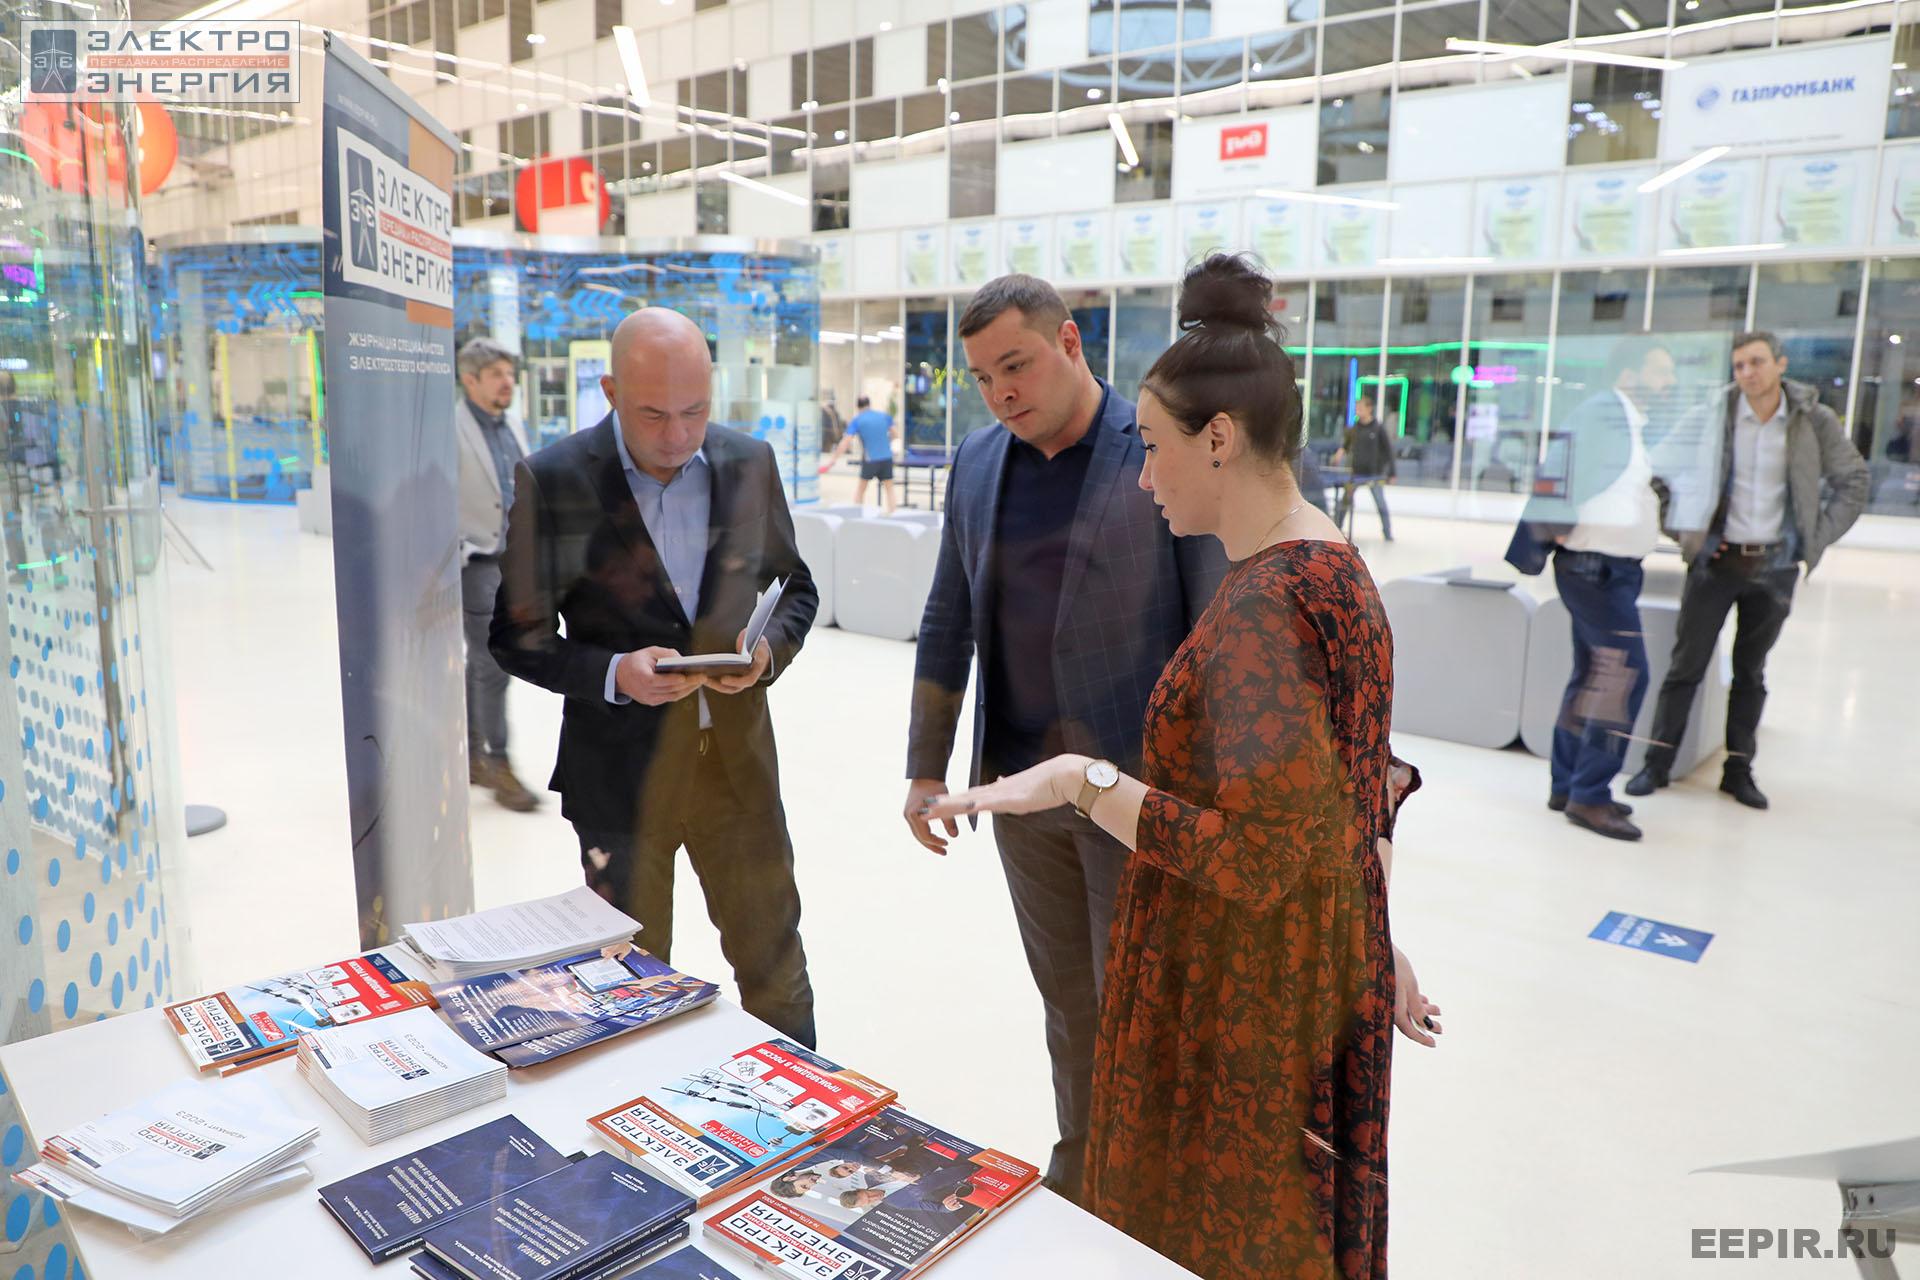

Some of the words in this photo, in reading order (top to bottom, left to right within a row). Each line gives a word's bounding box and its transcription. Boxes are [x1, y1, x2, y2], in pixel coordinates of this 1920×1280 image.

[1732, 76, 1857, 102] ГАЗПРОМБАНК
[180, 1005, 214, 1045] ЭЛЕКТРО
[201, 1000, 237, 1038] ЭНЕРГИЯ
[367, 1043, 406, 1074] ЭЛЕКТРО
[382, 1039, 422, 1070] ЭНЕРГИЯ
[756, 1047, 787, 1063] РОССИИ
[788, 1064, 842, 1092] ПРОИЗВОДИМ
[174, 1110, 206, 1125] 2023
[136, 1129, 196, 1156] ЭЛЕКТРО
[153, 1120, 212, 1147] ЭНЕРГИЯ
[609, 1116, 689, 1166] ЭЛЕКТРО
[628, 1107, 709, 1156] ЭНЕРГИЯ
[701, 1123, 745, 1148] АРМАТЕХ
[395, 1200, 424, 1225] ОЦЕНКА
[874, 1210, 911, 1229] аттестацию
[741, 1213, 799, 1246] РАСПРЕДЕЛЕНИЕ
[748, 1204, 852, 1265] ЭНЕРГИЯ
[860, 1218, 890, 1233] силового
[877, 1219, 908, 1235] первыми
[887, 1232, 914, 1244] защиты
[908, 1227, 936, 1241] прошли
[924, 1228, 941, 1237] ПАО
[515, 1242, 552, 1266] ОЦЕНКА
[730, 1216, 833, 1278] ЭЛЕКТРО
[801, 1246, 840, 1268] ПЕРЕДАЧА
[888, 1247, 913, 1260] Трубы
